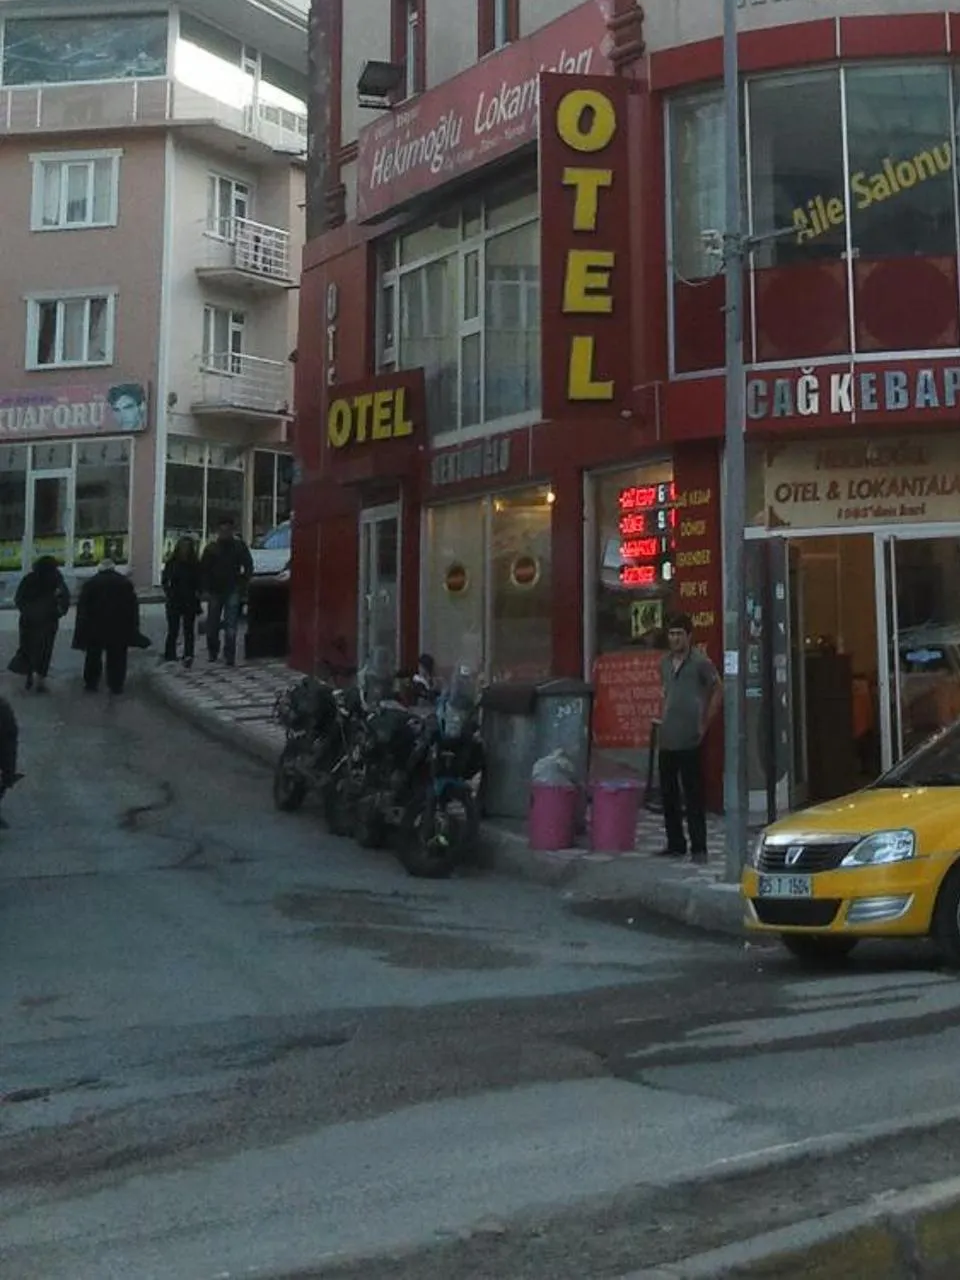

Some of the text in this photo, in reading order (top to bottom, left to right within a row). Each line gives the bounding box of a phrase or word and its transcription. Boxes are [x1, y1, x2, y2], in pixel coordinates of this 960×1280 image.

[370, 110, 463, 190] Hekimoğlu
[474, 46, 594, 136] Lokanları
[792, 140, 953, 245] Aile Salonu
[556, 88, 617, 401] OTEL
[327, 387, 414, 449] OTEL
[747, 367, 820, 419] CAĞ
[774, 482, 820, 504] OTEL
